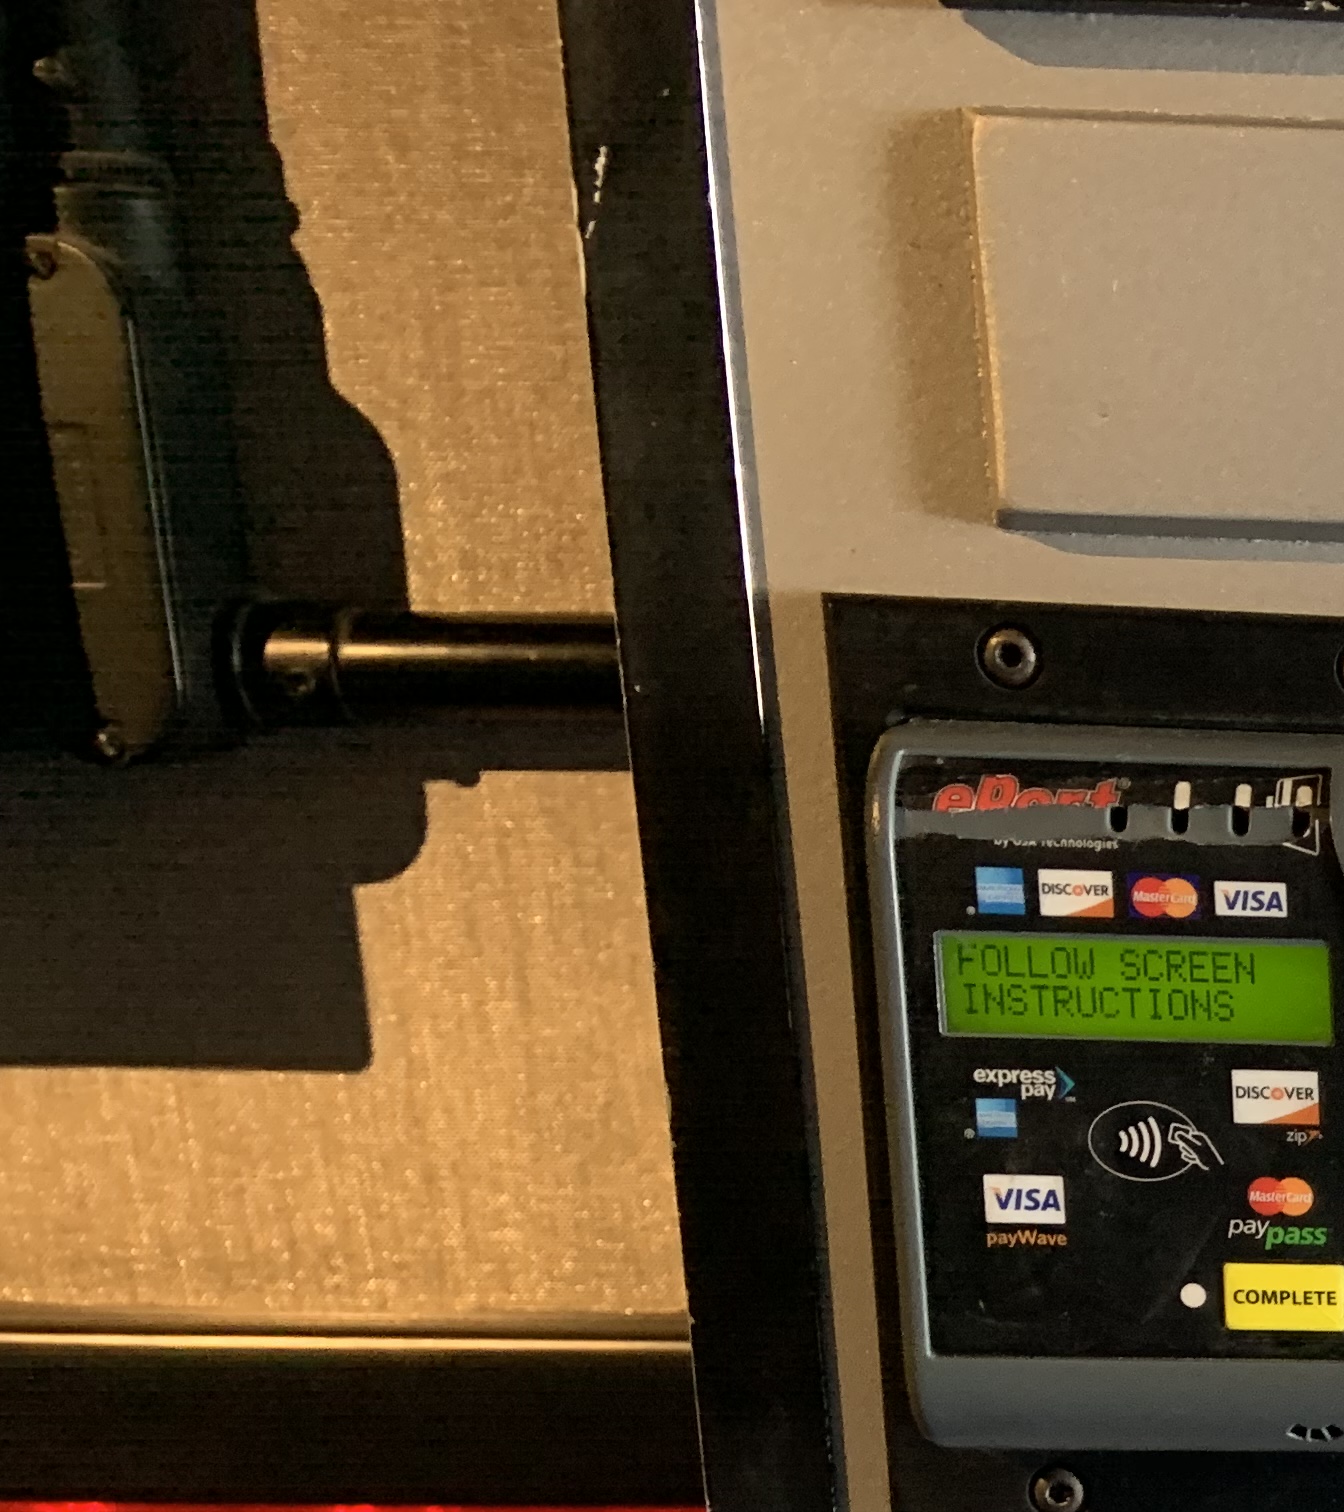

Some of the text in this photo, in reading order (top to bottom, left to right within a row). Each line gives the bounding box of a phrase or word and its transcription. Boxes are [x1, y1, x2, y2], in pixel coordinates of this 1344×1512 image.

[1041, 883, 1110, 897] DISCOVER
[1133, 890, 1198, 904] MasterCard
[1219, 889, 1284, 912] VISA
[957, 944, 1255, 984] FOLLOW SCREEN
[963, 983, 1234, 1021] INSTRUCTIONS
[973, 1068, 1056, 1085] express
[1021, 1084, 1055, 1100] pay
[1235, 1086, 1315, 1100] DISCOVER
[990, 1187, 1061, 1212] VISA
[1249, 1191, 1313, 1204] MasterCard
[986, 1230, 1068, 1248] payWave
[1233, 1290, 1337, 1306] COMPLETE
